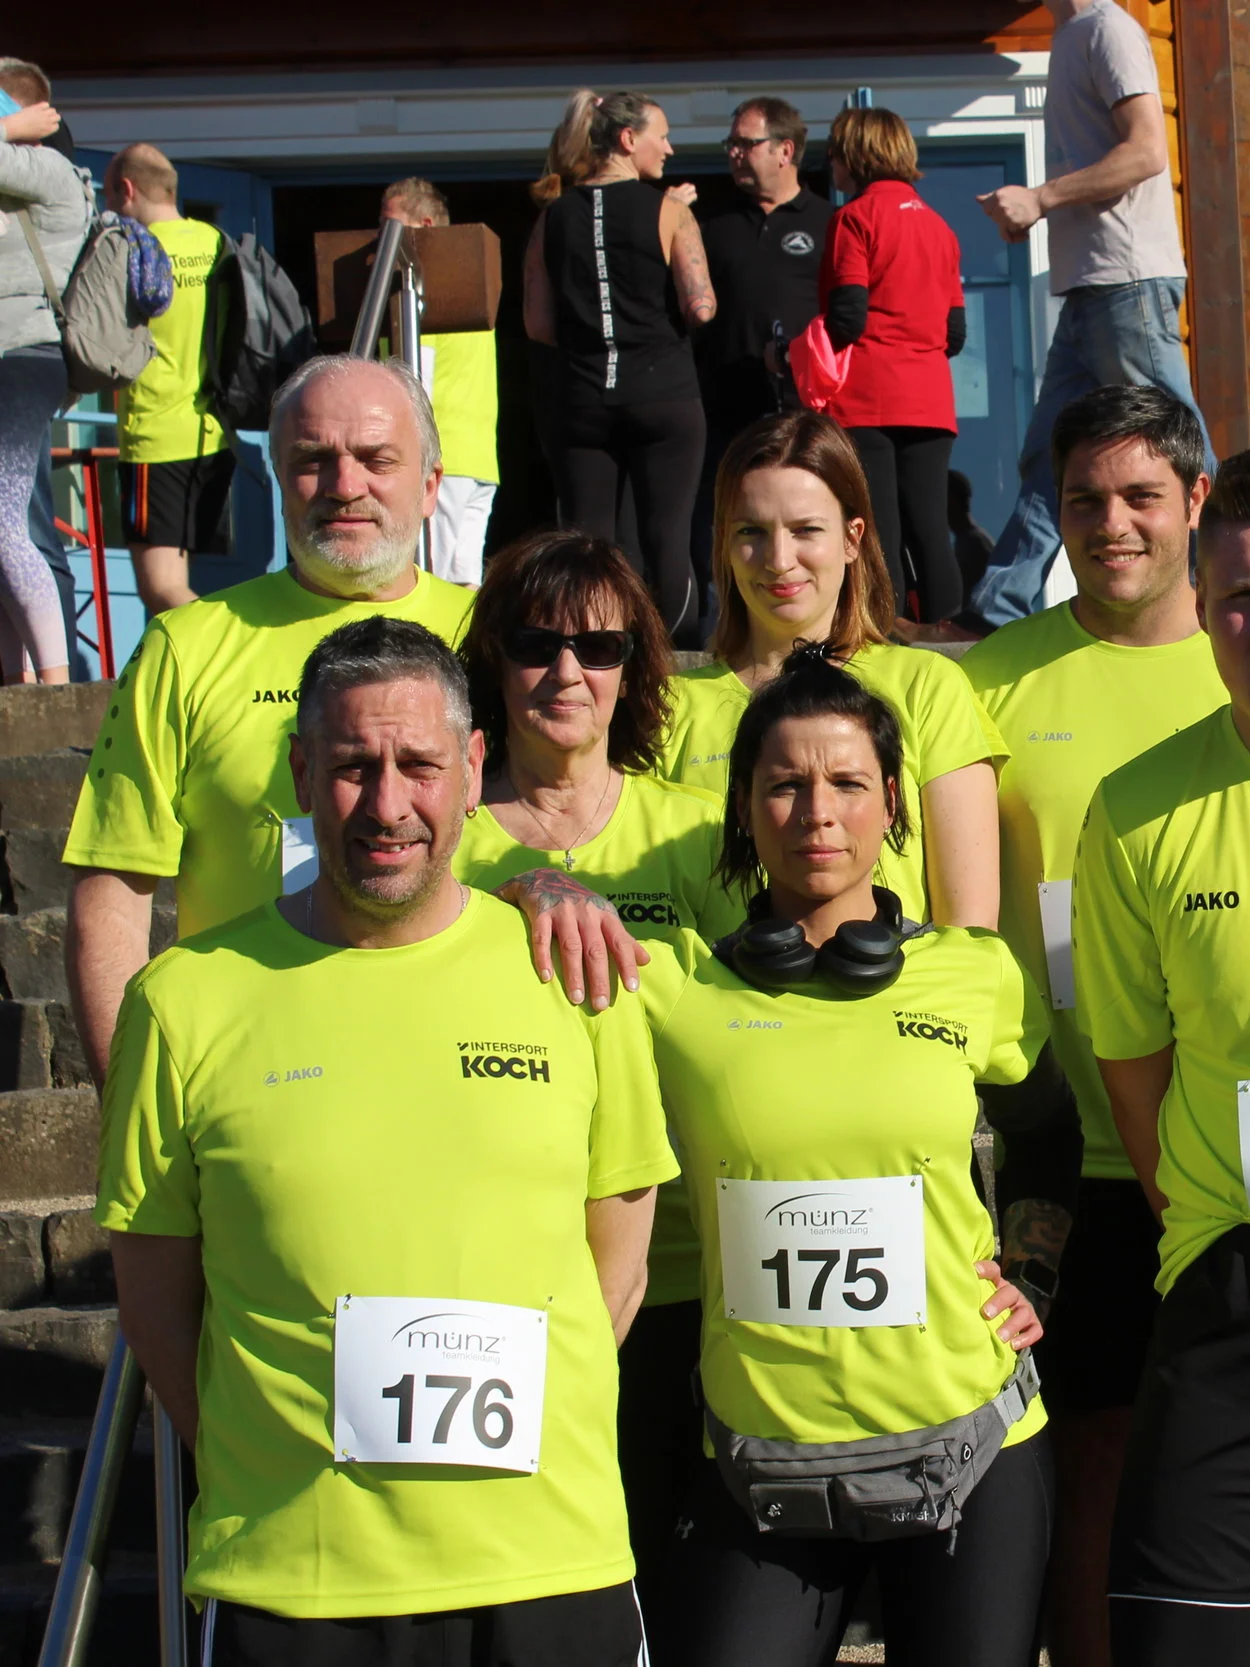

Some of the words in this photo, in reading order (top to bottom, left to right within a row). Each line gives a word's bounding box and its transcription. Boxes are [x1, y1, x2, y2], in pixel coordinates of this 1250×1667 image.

[1043, 732, 1073, 742] JAKO
[1184, 891, 1240, 912] JAKO
[745, 1020, 783, 1030] JAKO
[904, 1011, 968, 1035] INTERSPORT
[896, 1020, 968, 1055] KOCH
[471, 1042, 548, 1056] INTERSPORT
[284, 1066, 323, 1083] JAKO
[460, 1055, 550, 1083] KOCH
[810, 1226, 869, 1236] teamkleidung
[761, 1247, 889, 1312] 175
[382, 1374, 514, 1449] 176
